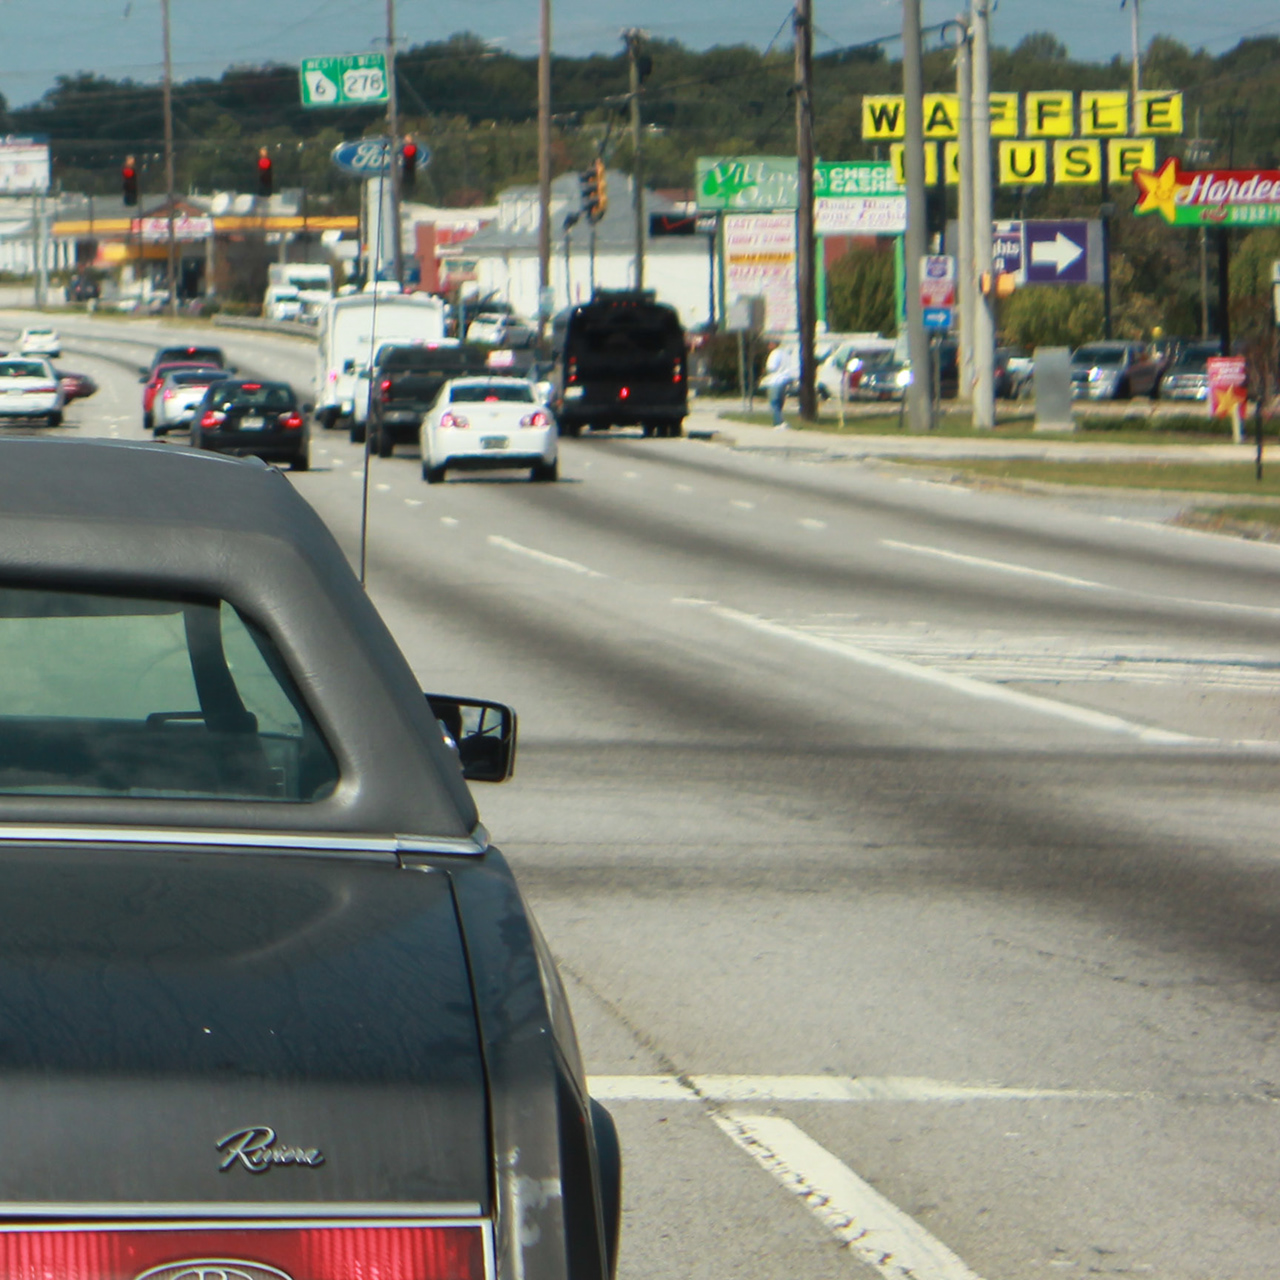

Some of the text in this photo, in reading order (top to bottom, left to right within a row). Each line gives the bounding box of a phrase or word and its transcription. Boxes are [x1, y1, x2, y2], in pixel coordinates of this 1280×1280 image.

[315, 78, 326, 95] 6
[347, 72, 381, 93] 278
[868, 98, 1173, 133] WAFFLE
[215, 1125, 326, 1174] Riviera
